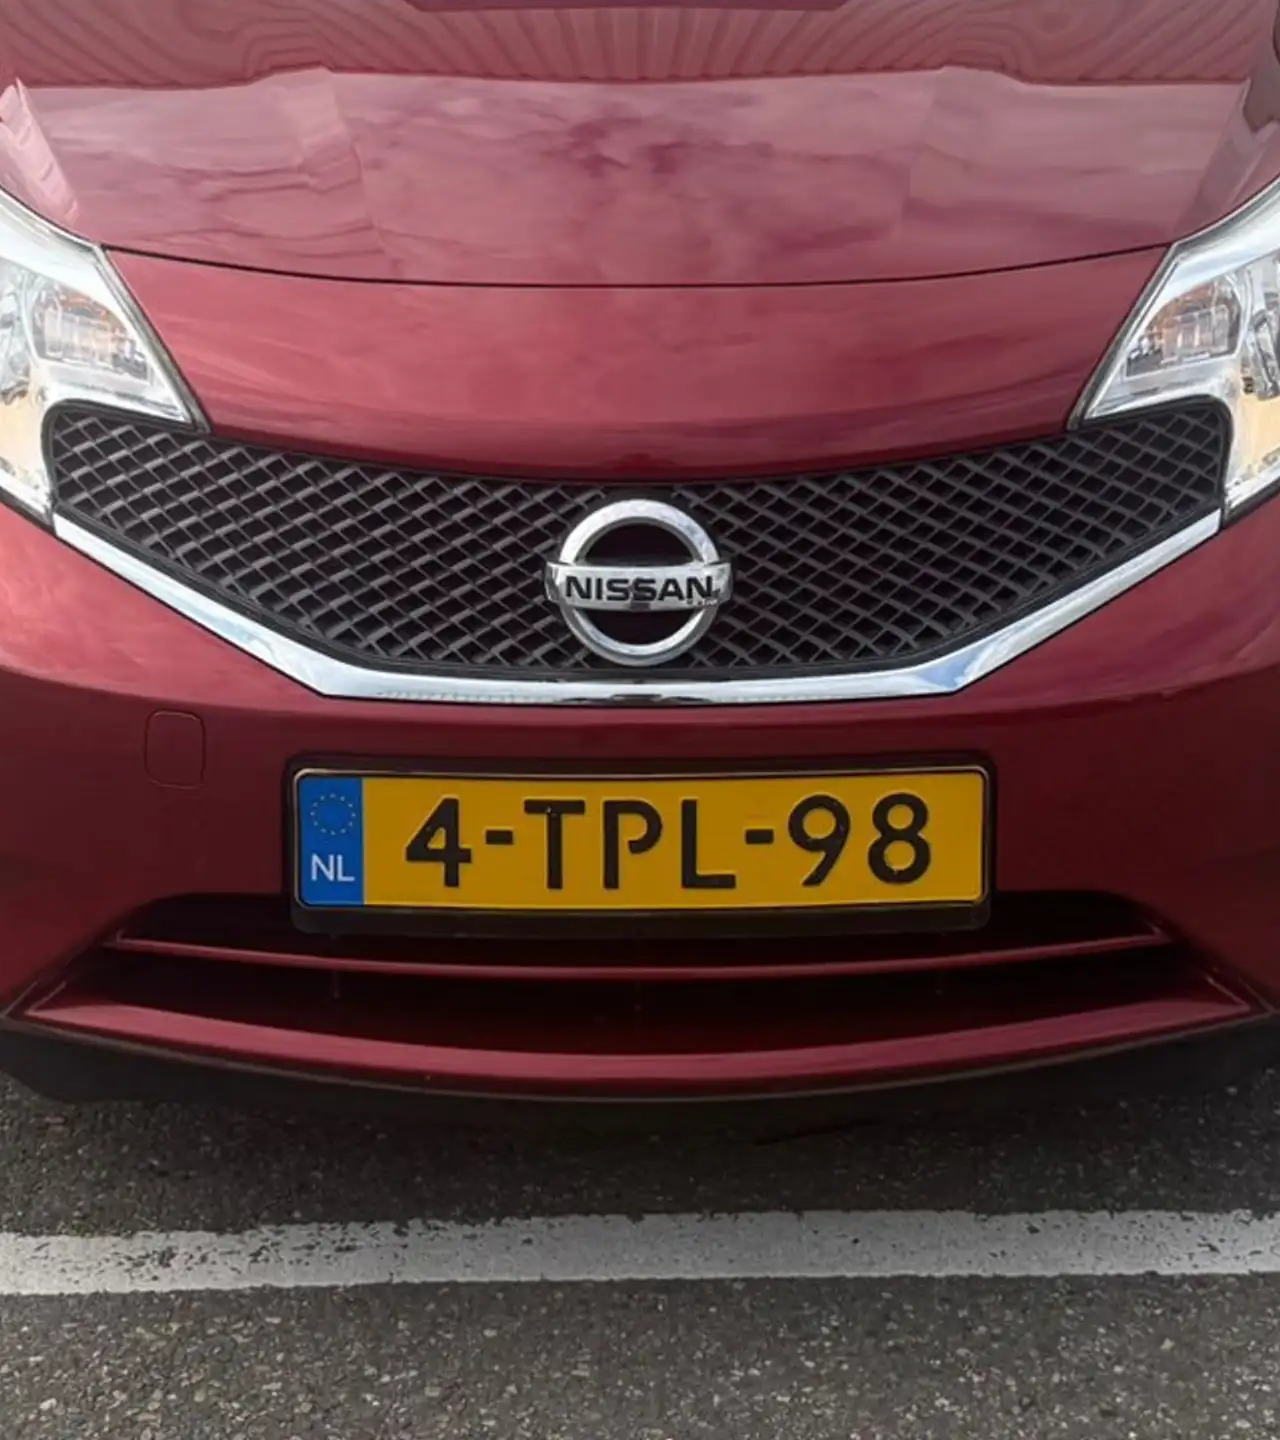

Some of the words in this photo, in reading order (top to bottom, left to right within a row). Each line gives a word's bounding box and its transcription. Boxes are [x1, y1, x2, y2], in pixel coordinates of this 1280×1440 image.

[565, 574, 714, 602] NISSAN
[310, 853, 355, 883] NL
[405, 792, 932, 891] 4-TPL-98
